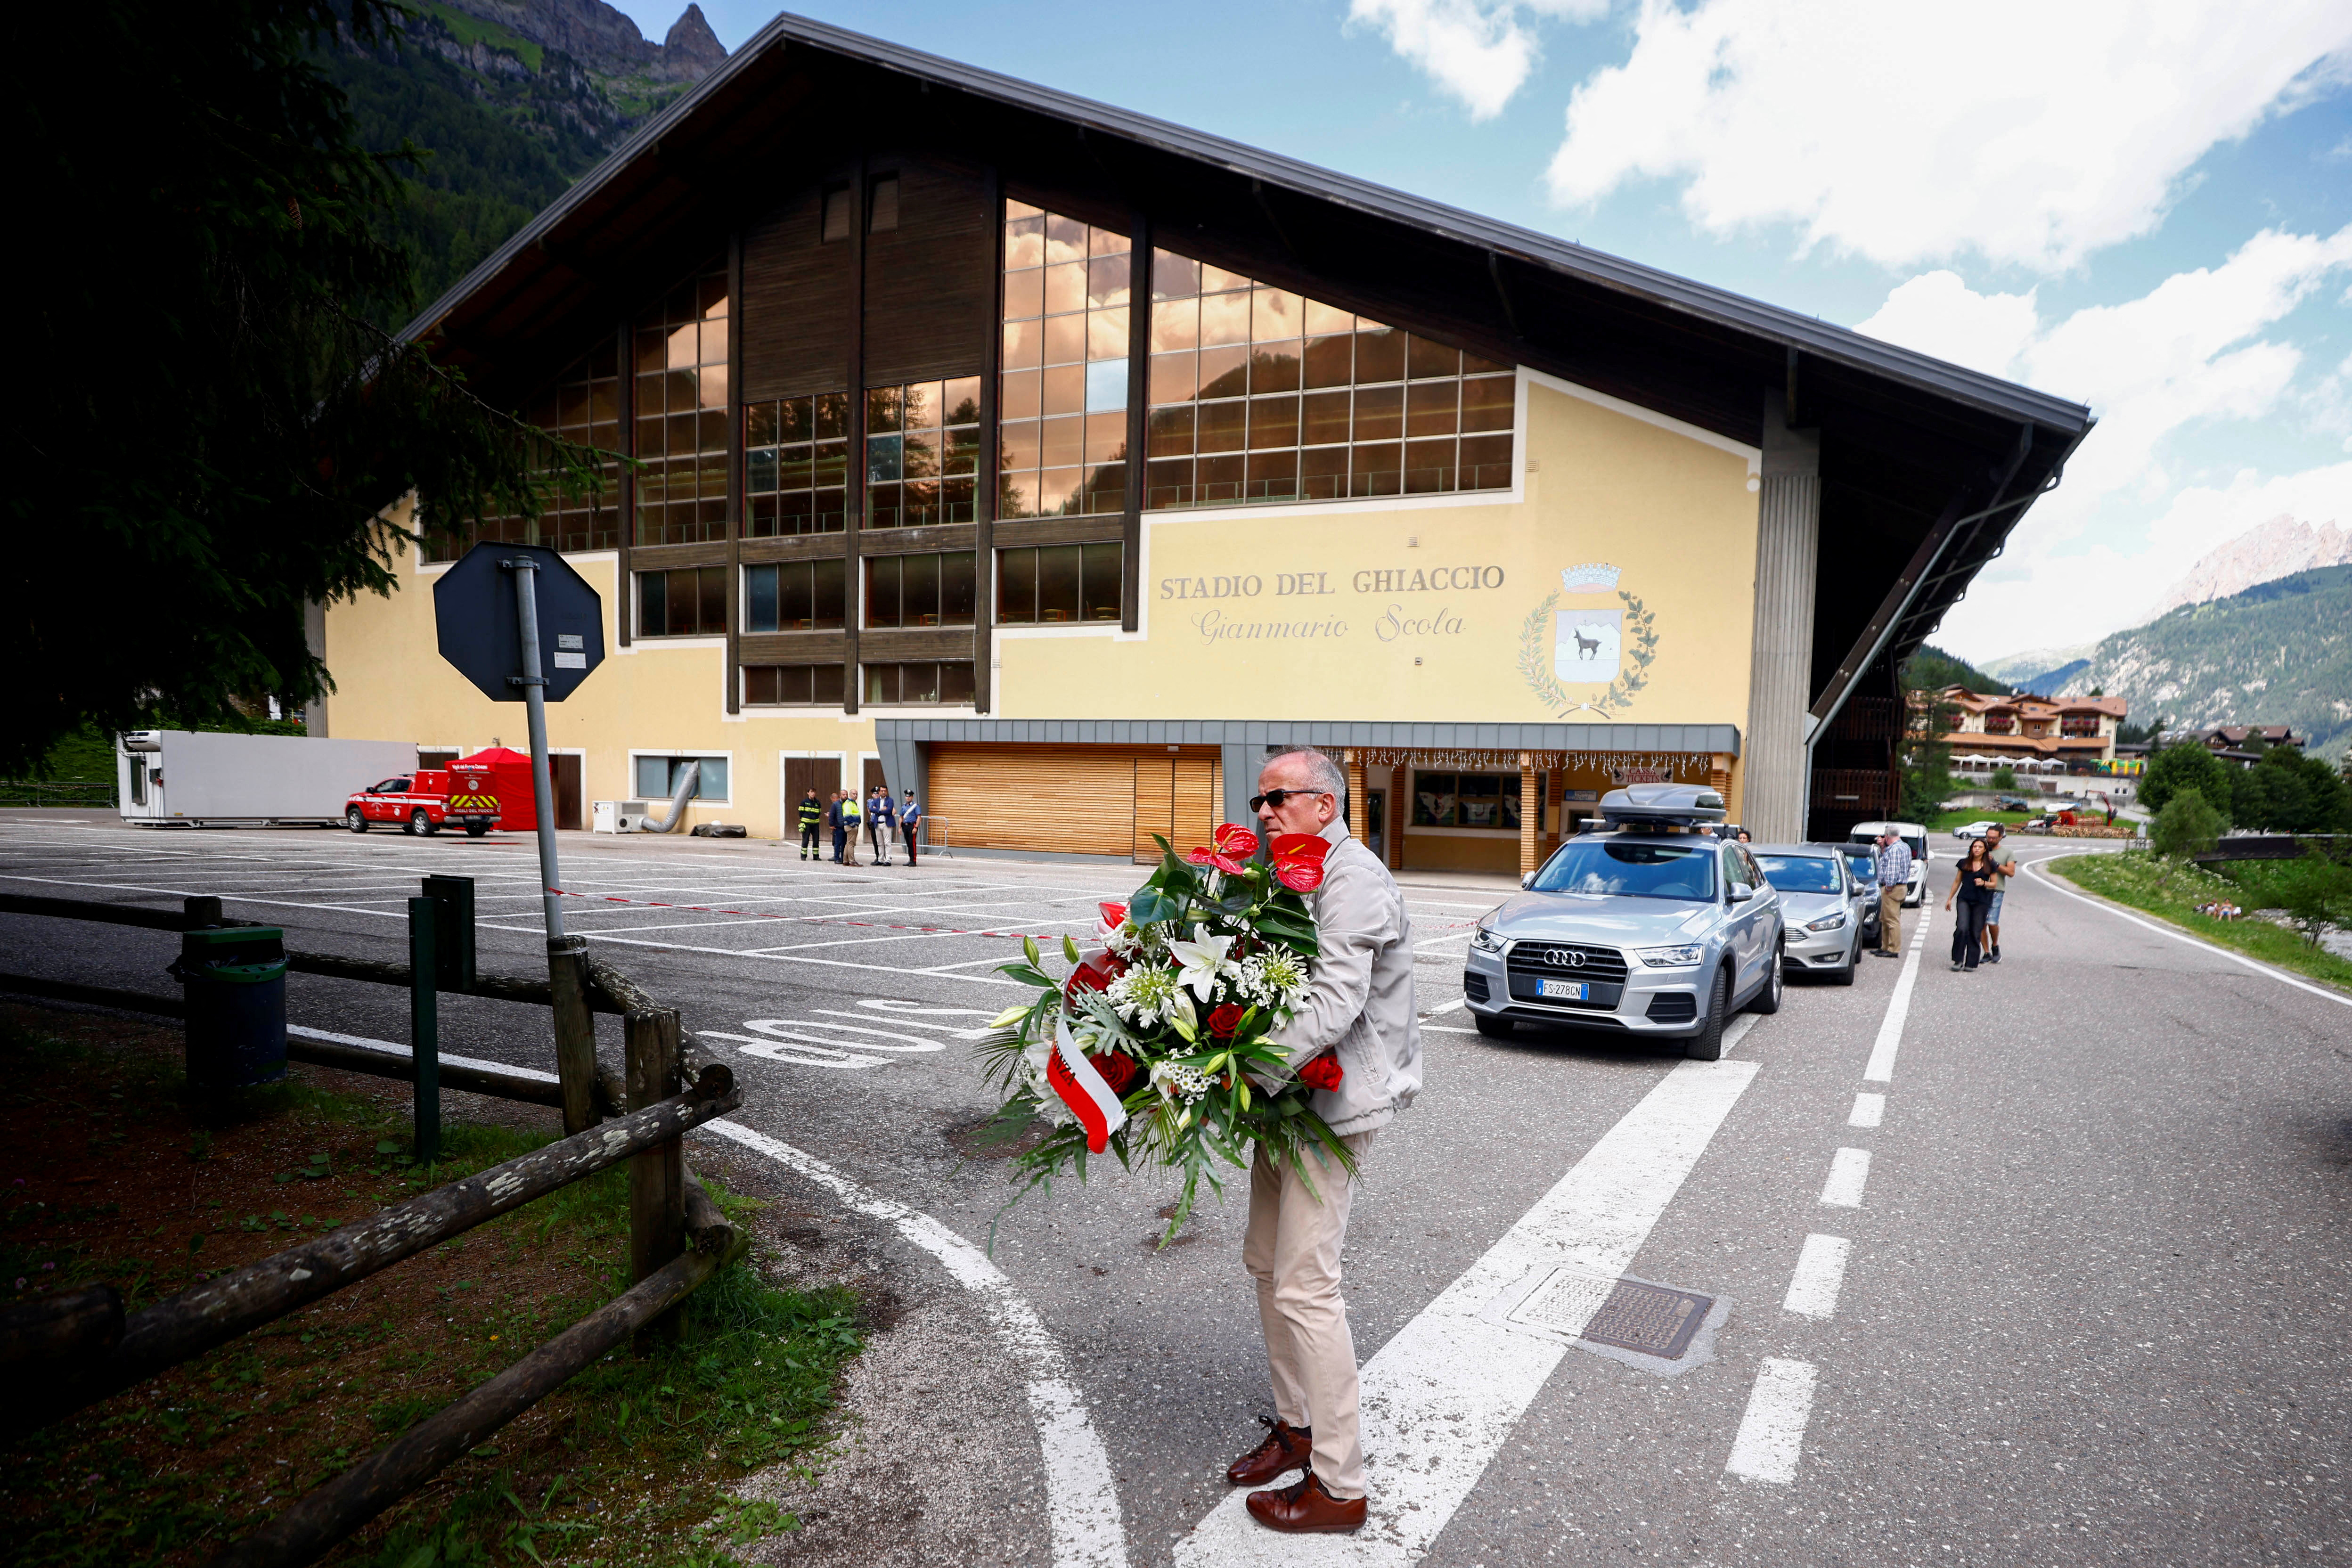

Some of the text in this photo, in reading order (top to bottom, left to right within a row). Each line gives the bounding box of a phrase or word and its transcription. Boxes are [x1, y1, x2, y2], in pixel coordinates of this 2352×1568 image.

[1160, 565, 1505, 600] STADIO DEL GHIACCIO
[1191, 604, 1466, 645] Gianmario Scola
[1626, 775, 1659, 783] TICKETS
